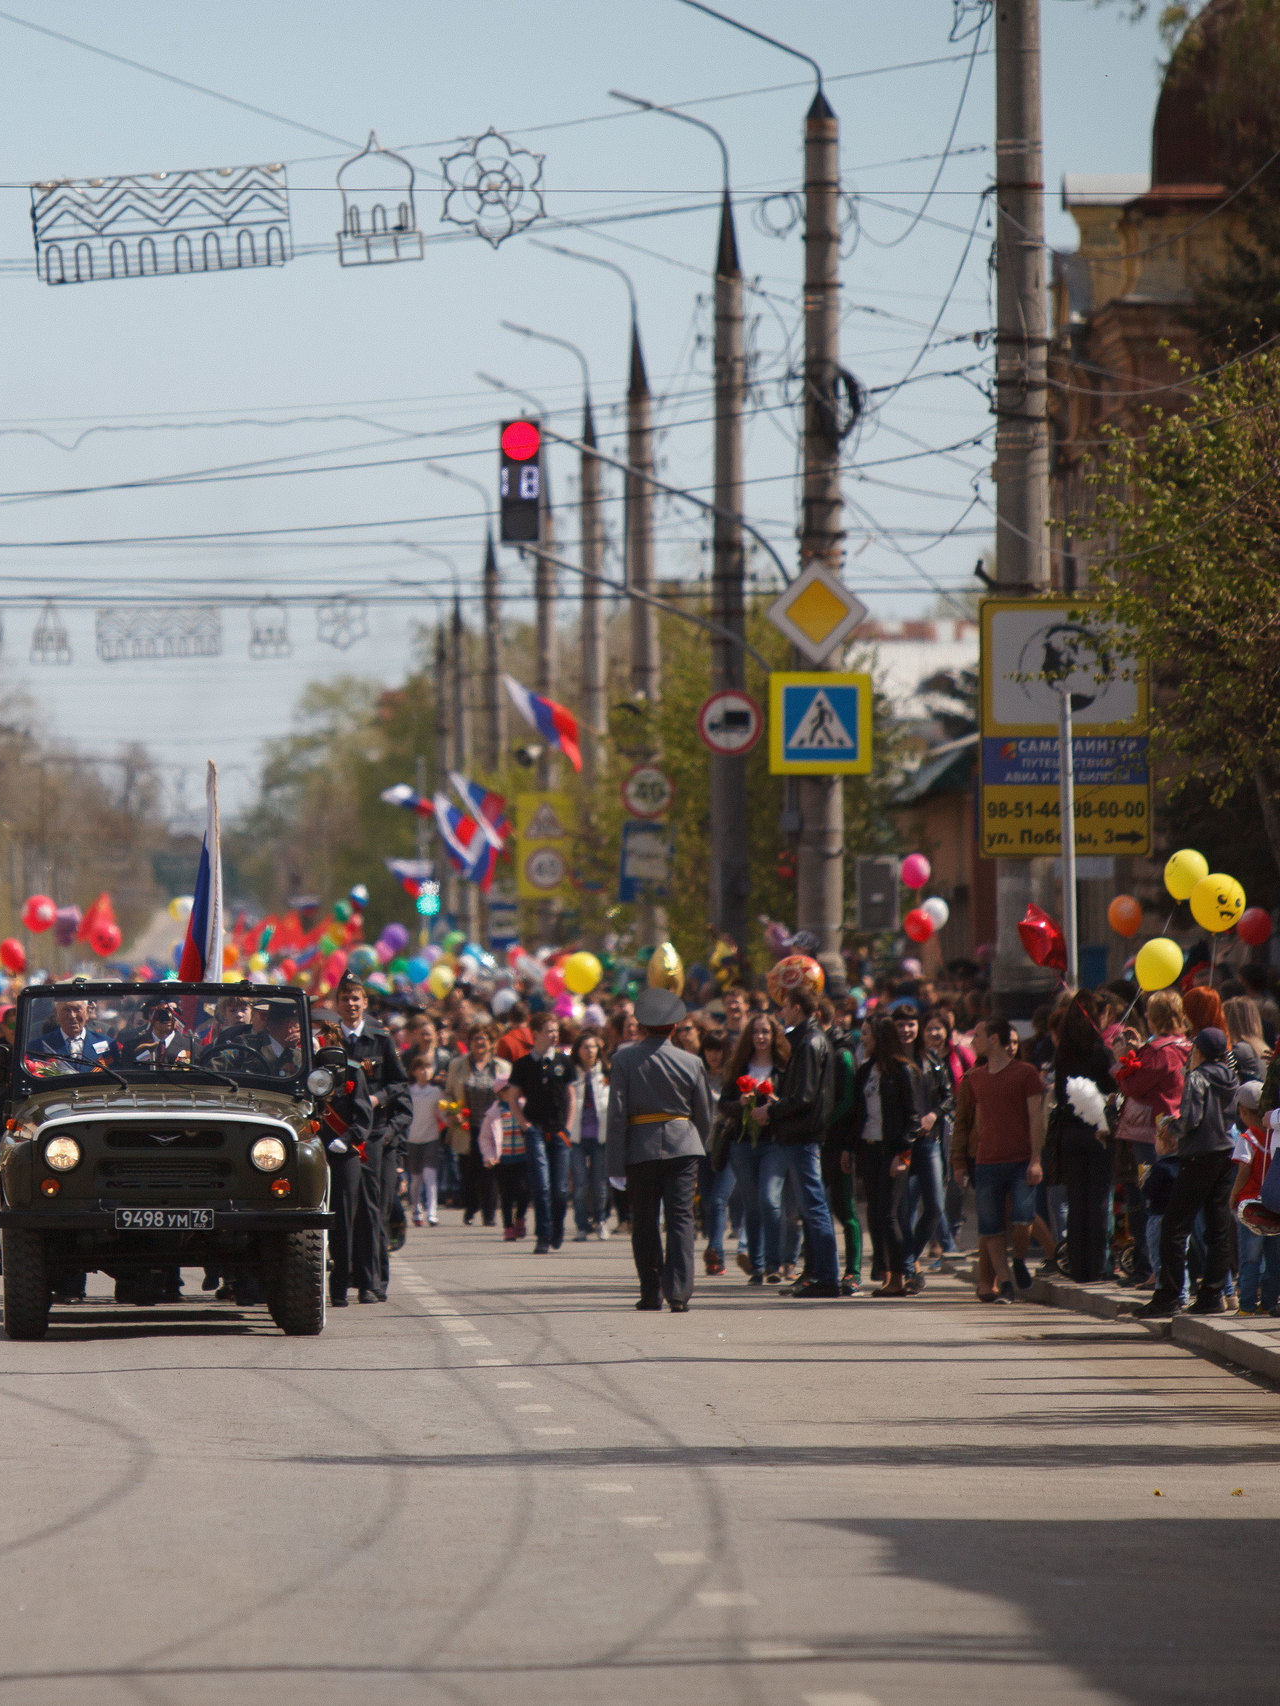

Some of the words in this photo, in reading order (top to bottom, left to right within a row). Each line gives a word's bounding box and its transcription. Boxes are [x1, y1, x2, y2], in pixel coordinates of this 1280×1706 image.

[500, 464, 540, 499] 18
[986, 801, 1061, 819] 98-51-44
[986, 830, 1013, 848] ул.
[122, 1210, 164, 1227] 9498
[191, 1210, 208, 1223] 76
